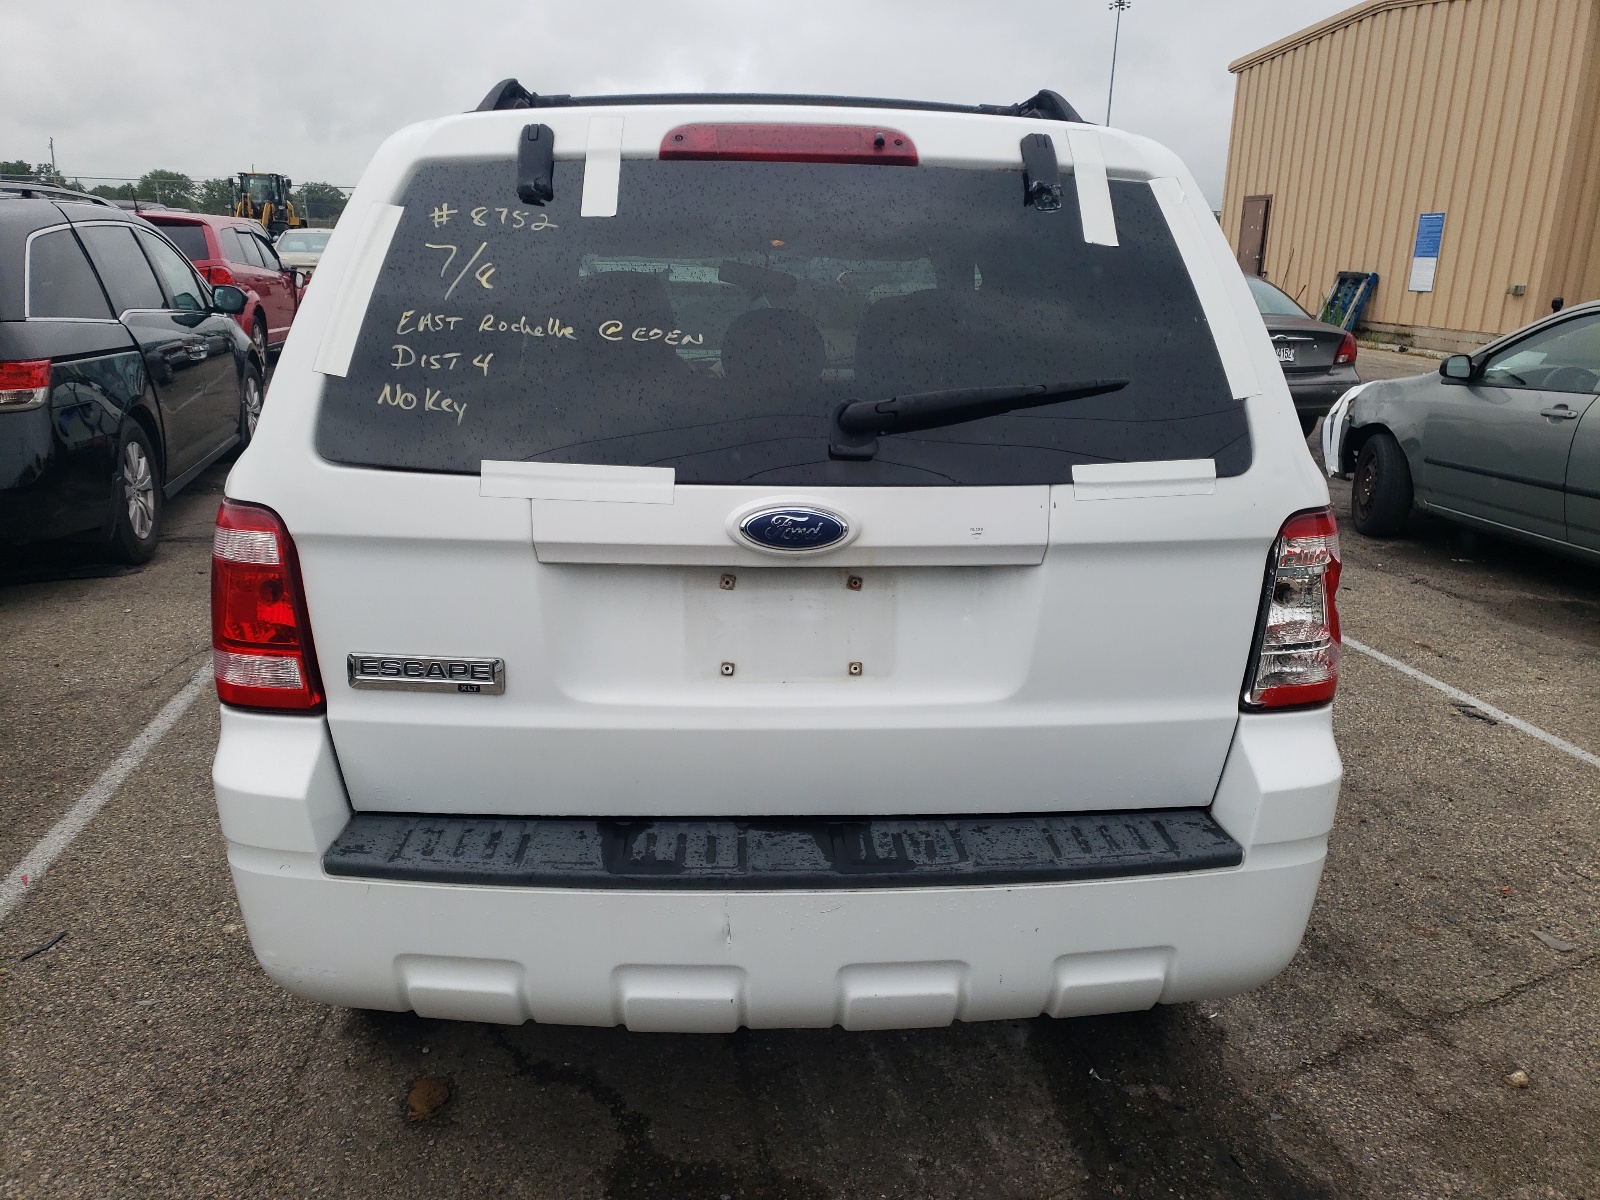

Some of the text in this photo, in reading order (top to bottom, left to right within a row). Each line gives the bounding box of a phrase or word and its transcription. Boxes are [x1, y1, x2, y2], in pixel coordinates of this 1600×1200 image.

[470, 206, 560, 231] 8752
[396, 310, 464, 335] EAST
[390, 344, 494, 377] DIST 4
[764, 514, 824, 541] Ford
[358, 658, 491, 681] ESCAPE
